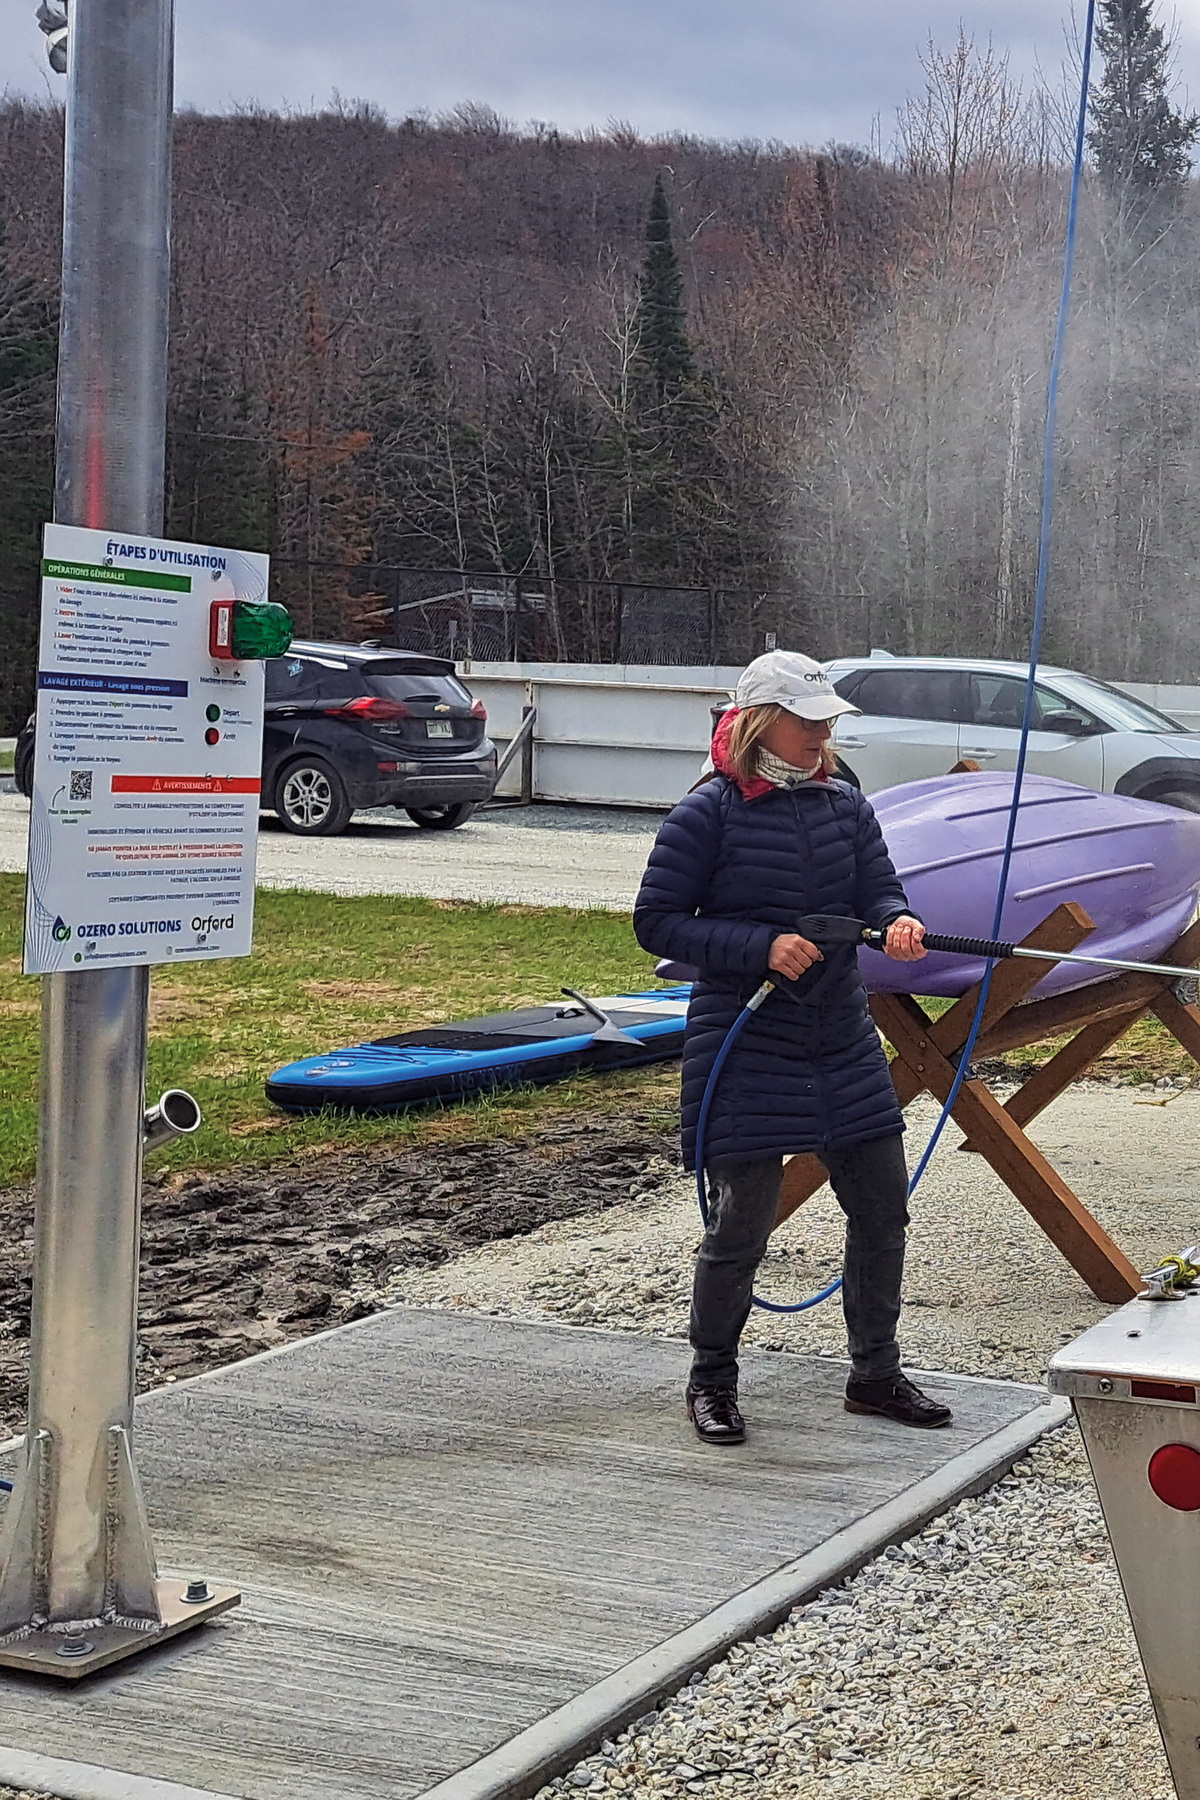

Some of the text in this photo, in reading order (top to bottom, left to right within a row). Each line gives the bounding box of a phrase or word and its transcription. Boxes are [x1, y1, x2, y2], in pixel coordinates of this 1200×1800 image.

[106, 539, 226, 570] ÉTAPES D'UTILISATION
[48, 564, 126, 581] OPÉRATIONS GÉNÉRALES
[43, 677, 69, 686] LAVAGE
[77, 920, 182, 938] OZERO SOLUTIONS
[191, 914, 234, 934] Orford
